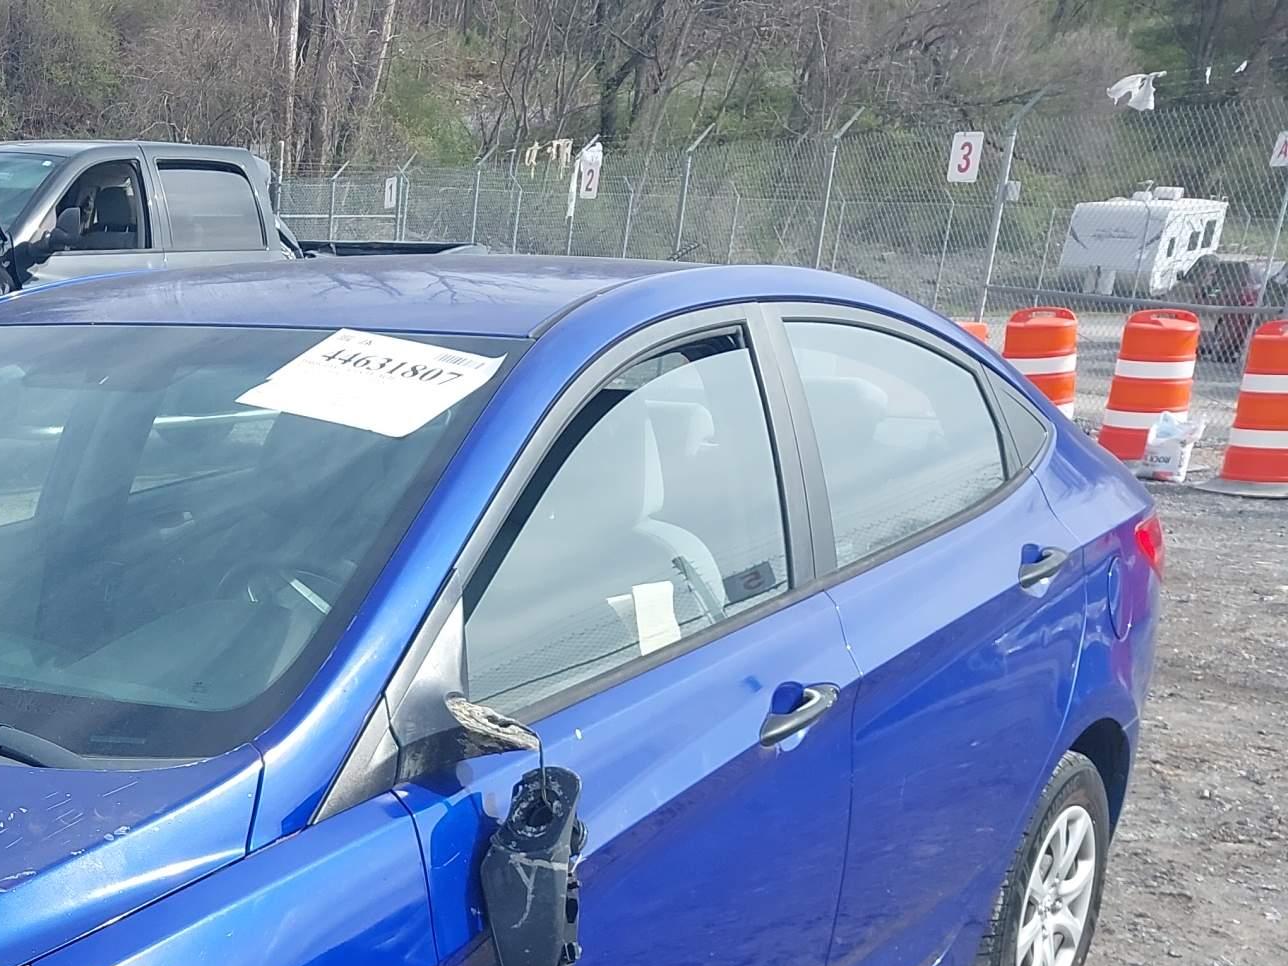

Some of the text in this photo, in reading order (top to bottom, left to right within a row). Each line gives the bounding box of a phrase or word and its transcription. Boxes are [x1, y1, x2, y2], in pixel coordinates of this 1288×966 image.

[957, 141, 973, 173] 3
[585, 168, 595, 192] 2
[321, 348, 464, 385] 44631807
